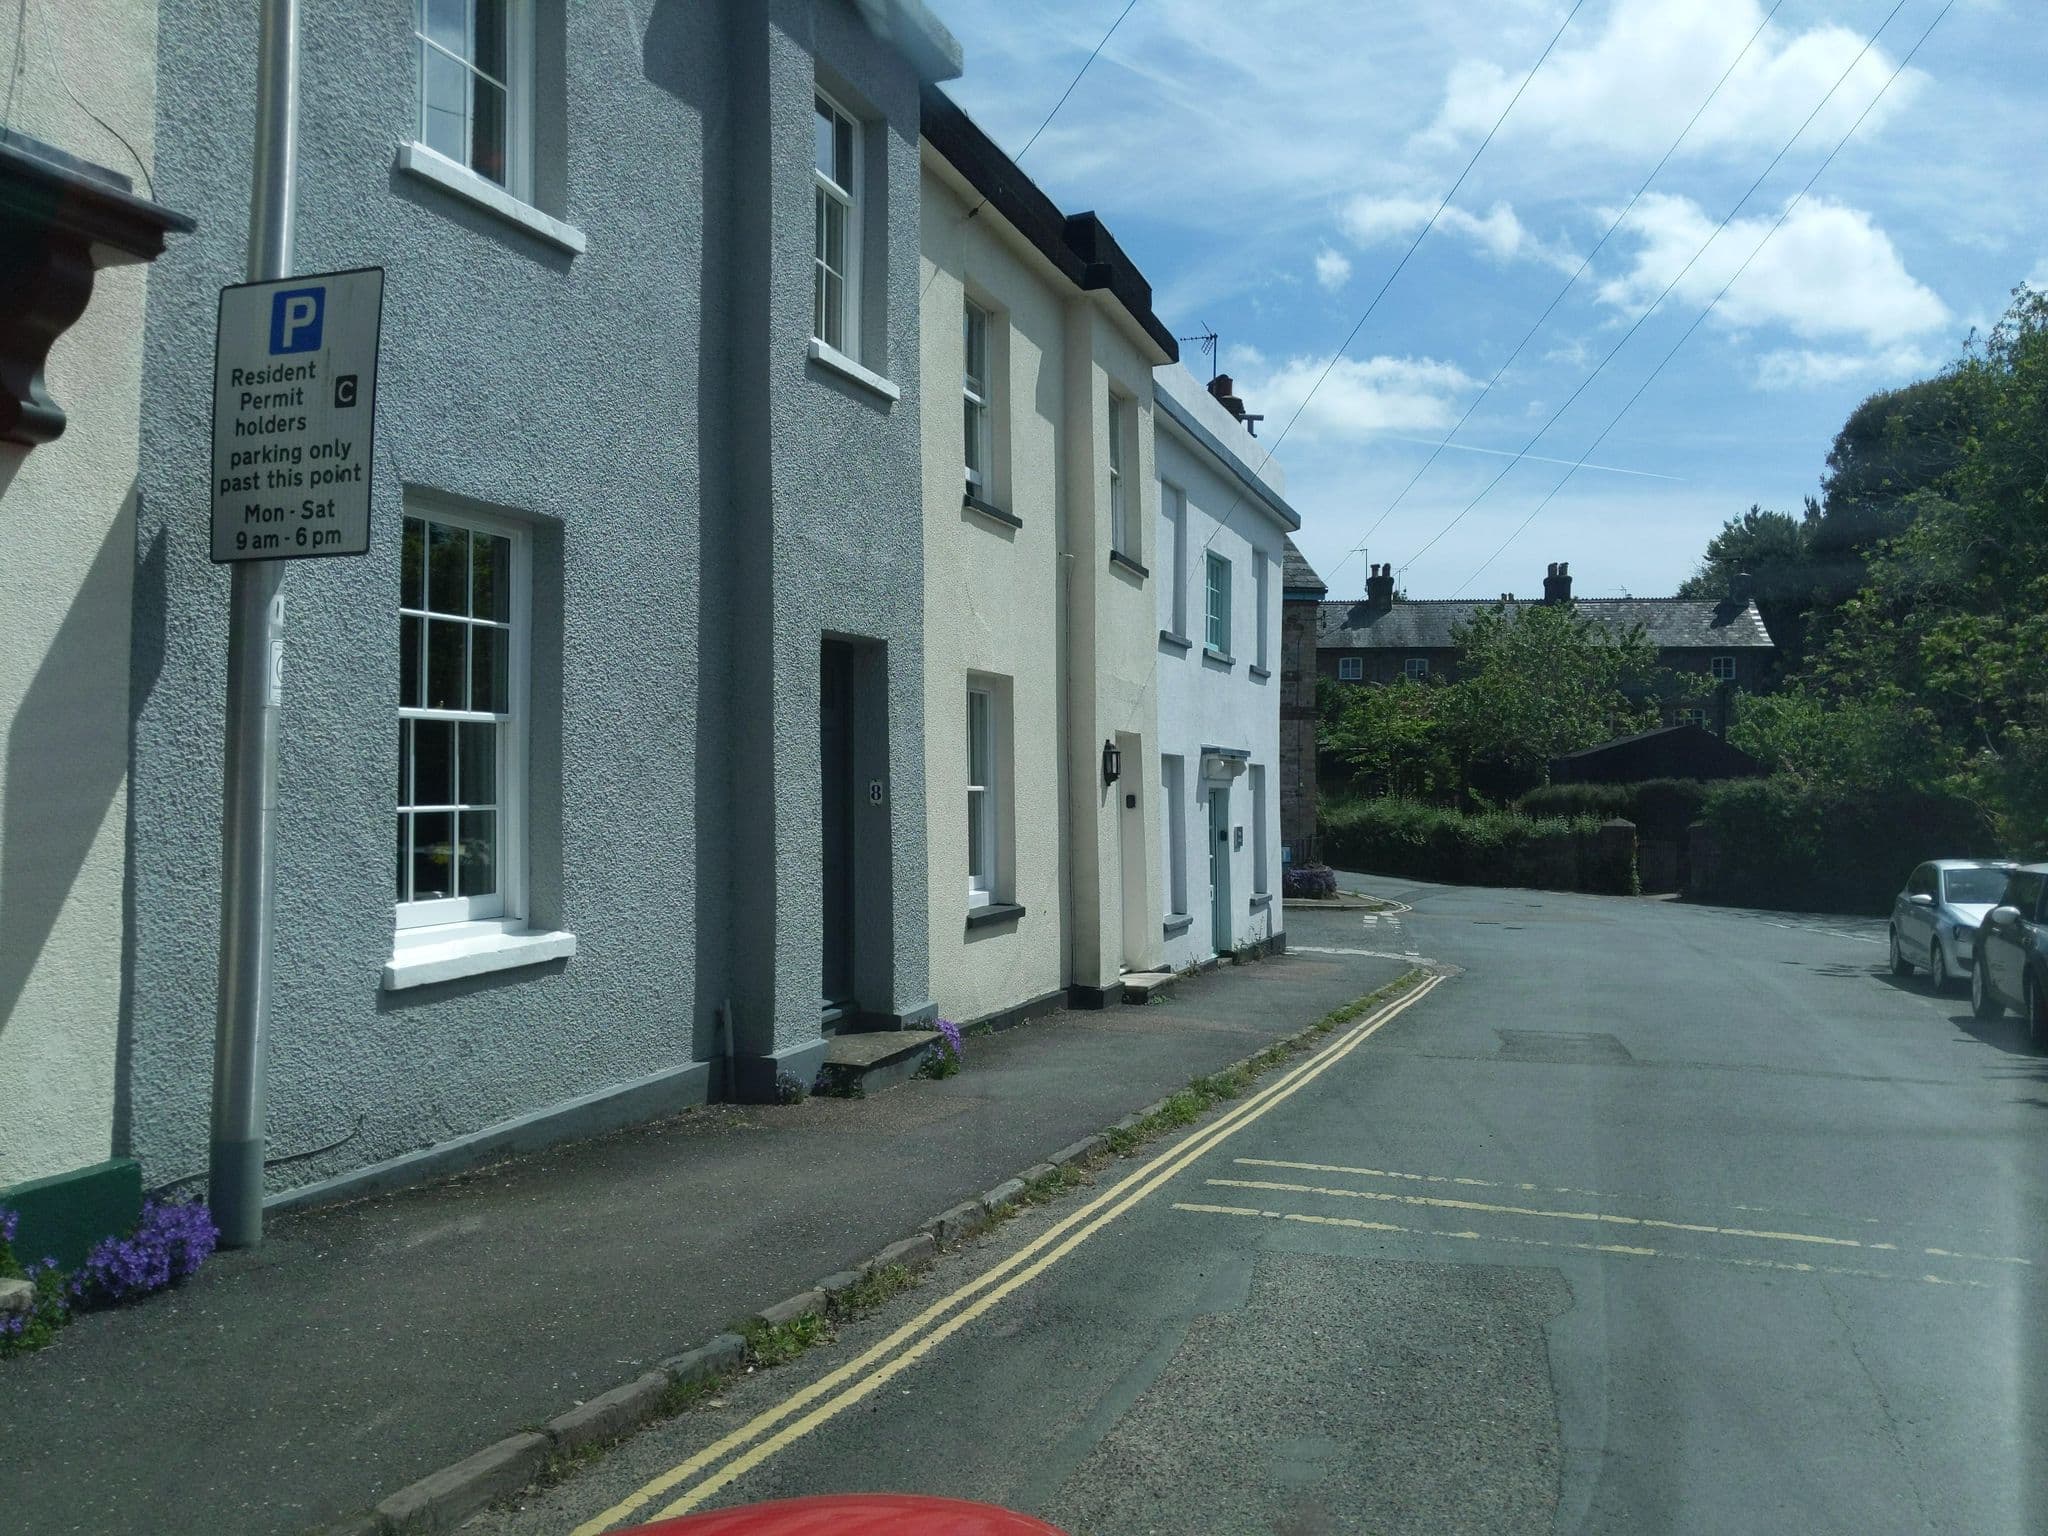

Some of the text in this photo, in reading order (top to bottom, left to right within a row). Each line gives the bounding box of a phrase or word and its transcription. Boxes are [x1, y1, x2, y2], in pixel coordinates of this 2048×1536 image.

[283, 296, 317, 348] P
[232, 361, 316, 387] Resident
[241, 387, 304, 410] Permit
[339, 381, 354, 402] C
[235, 414, 306, 436] holders
[231, 439, 351, 469] parking only
[220, 465, 361, 495] past this point
[245, 504, 284, 524] Mon
[301, 499, 335, 518] Sat
[871, 784, 881, 801] 8
